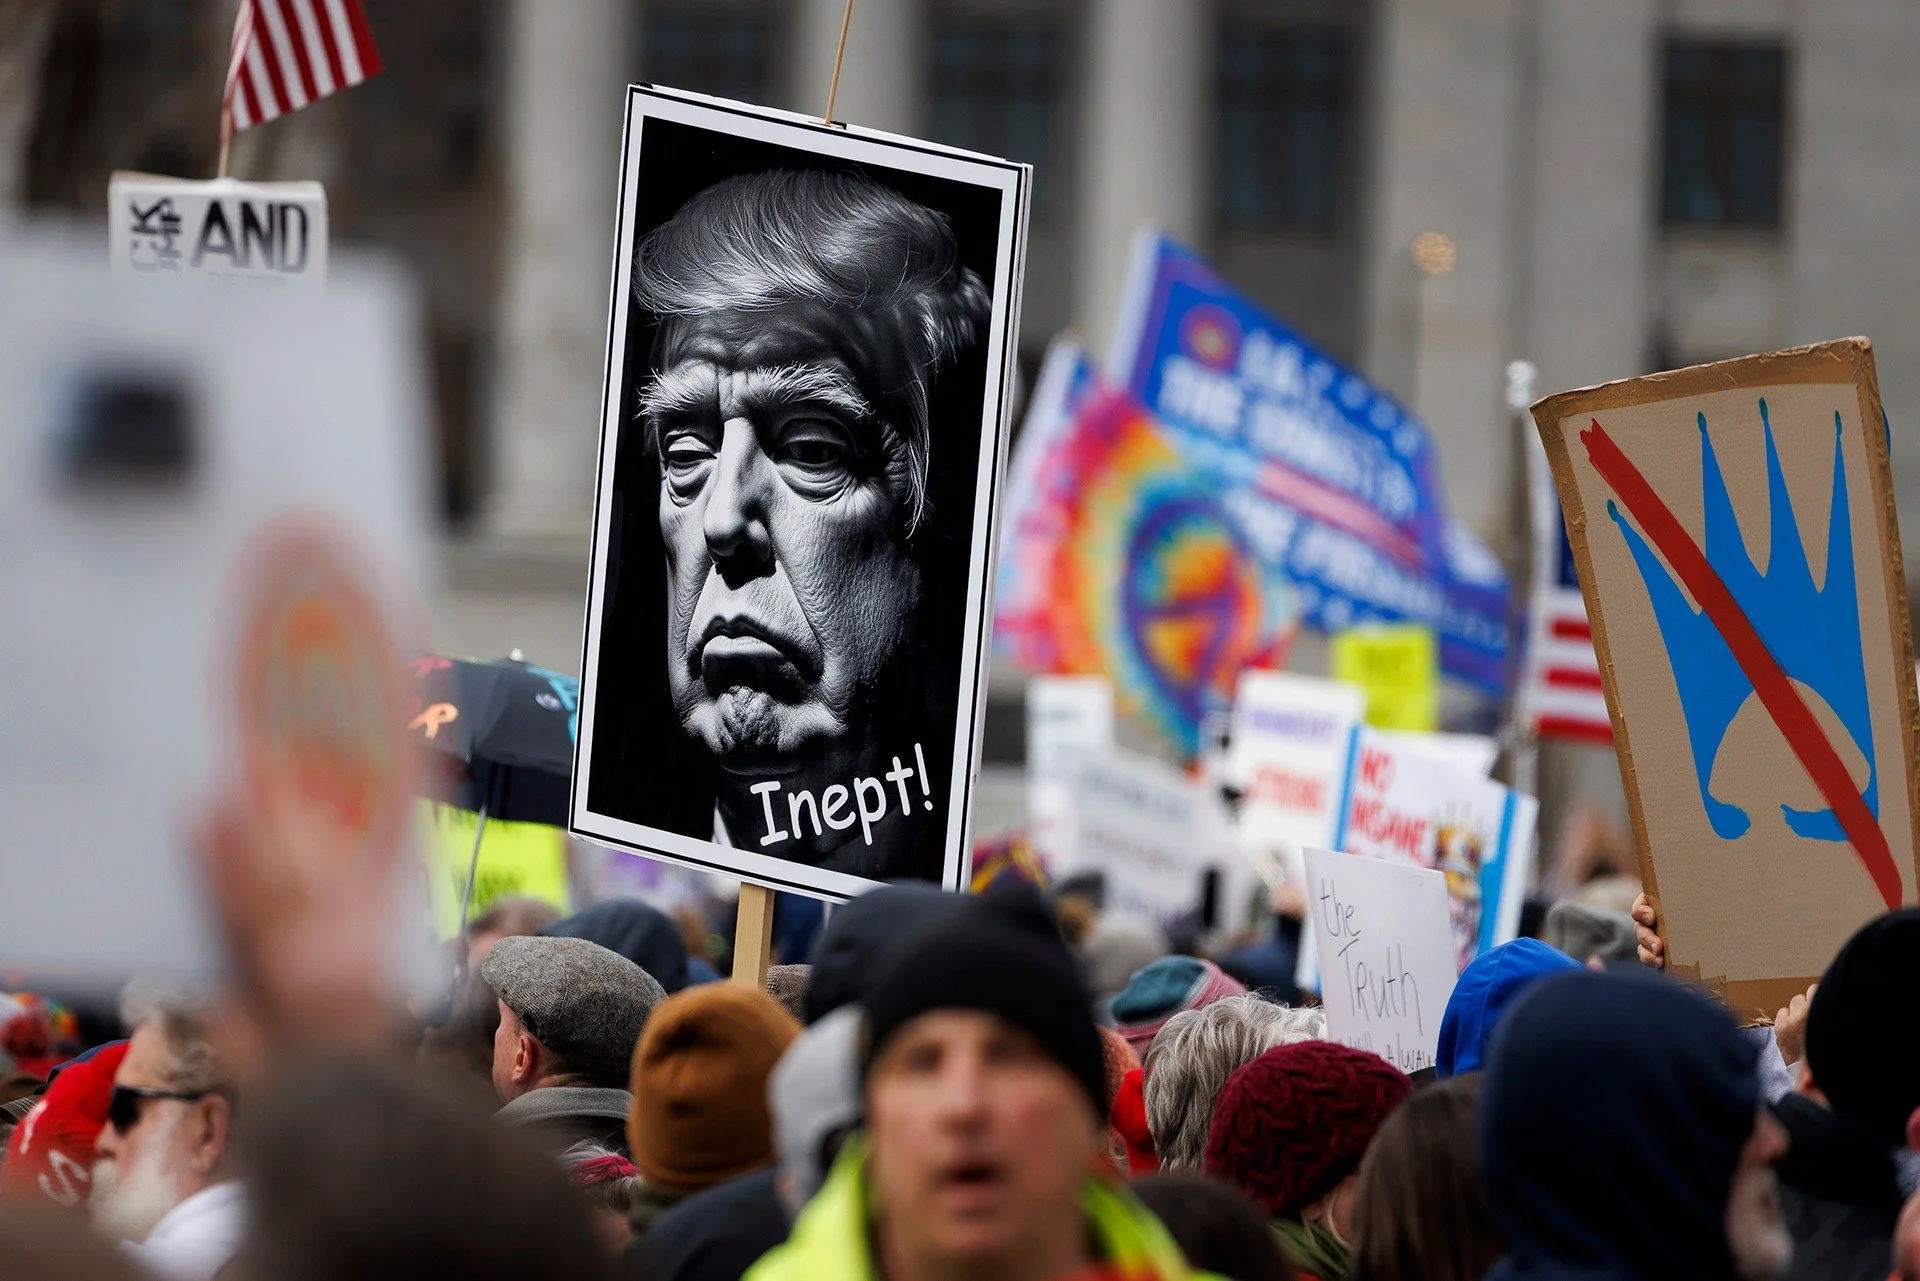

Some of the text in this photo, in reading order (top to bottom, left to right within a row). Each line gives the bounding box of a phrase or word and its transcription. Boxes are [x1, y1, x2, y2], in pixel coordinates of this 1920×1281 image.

[190, 199, 309, 273] AND
[750, 743, 933, 846] Inept!
[1320, 878, 1361, 937] the
